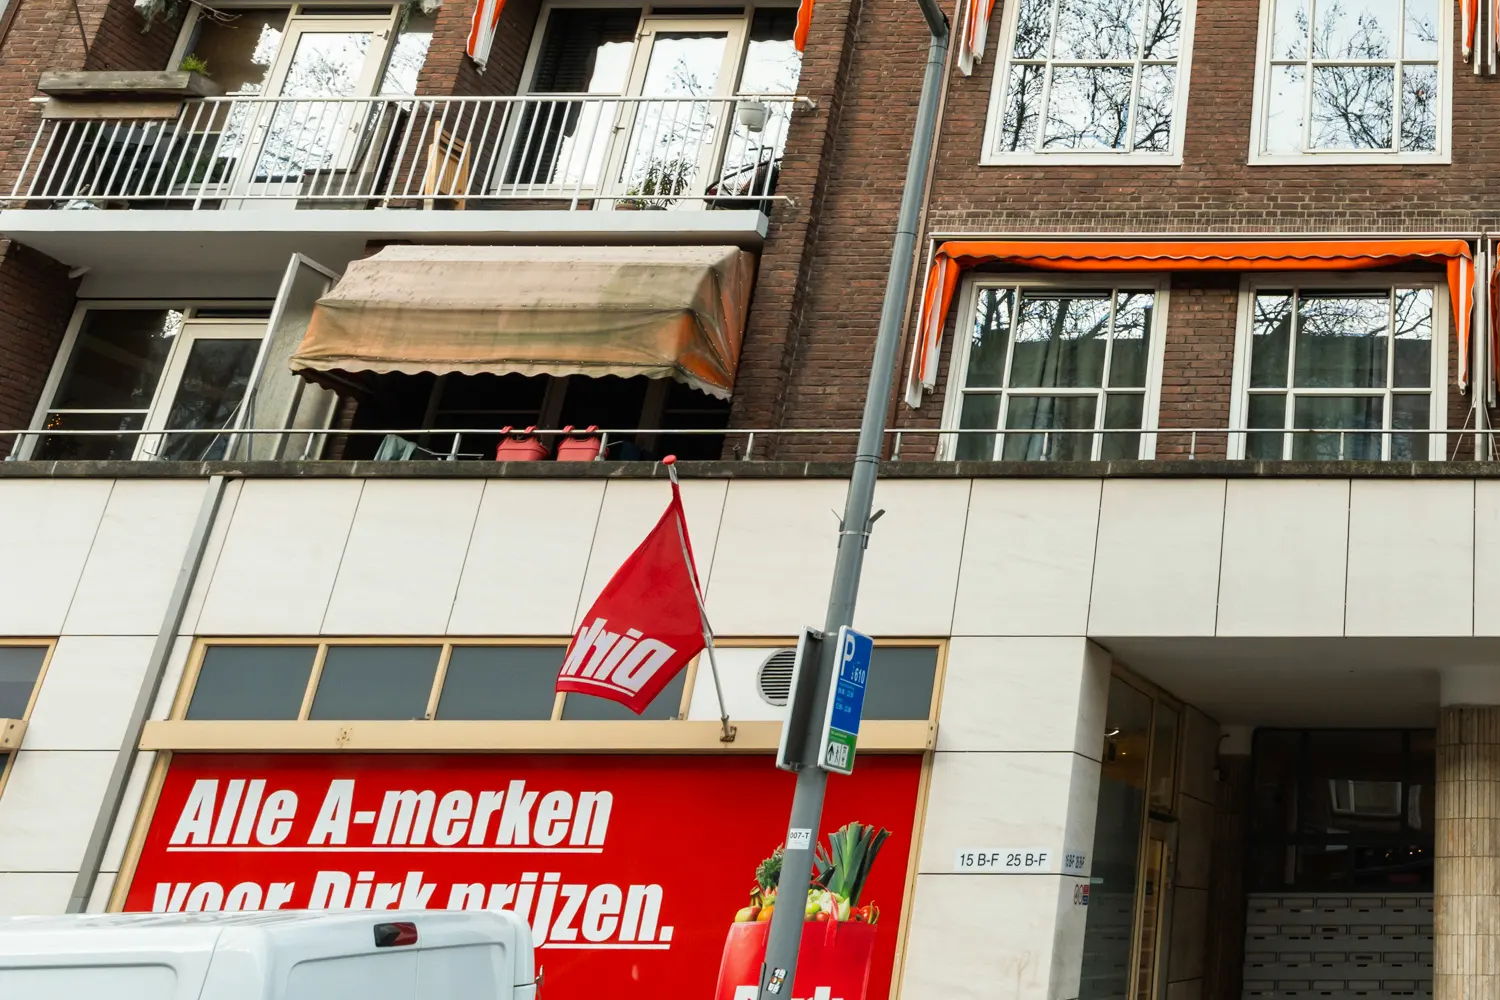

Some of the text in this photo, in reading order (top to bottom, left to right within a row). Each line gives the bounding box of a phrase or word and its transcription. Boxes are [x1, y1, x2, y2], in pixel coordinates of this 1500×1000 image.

[841, 634, 856, 676] P
[168, 779, 613, 846] Alle A-merken
[960, 853, 1047, 867] 15 B-F 25 B-F
